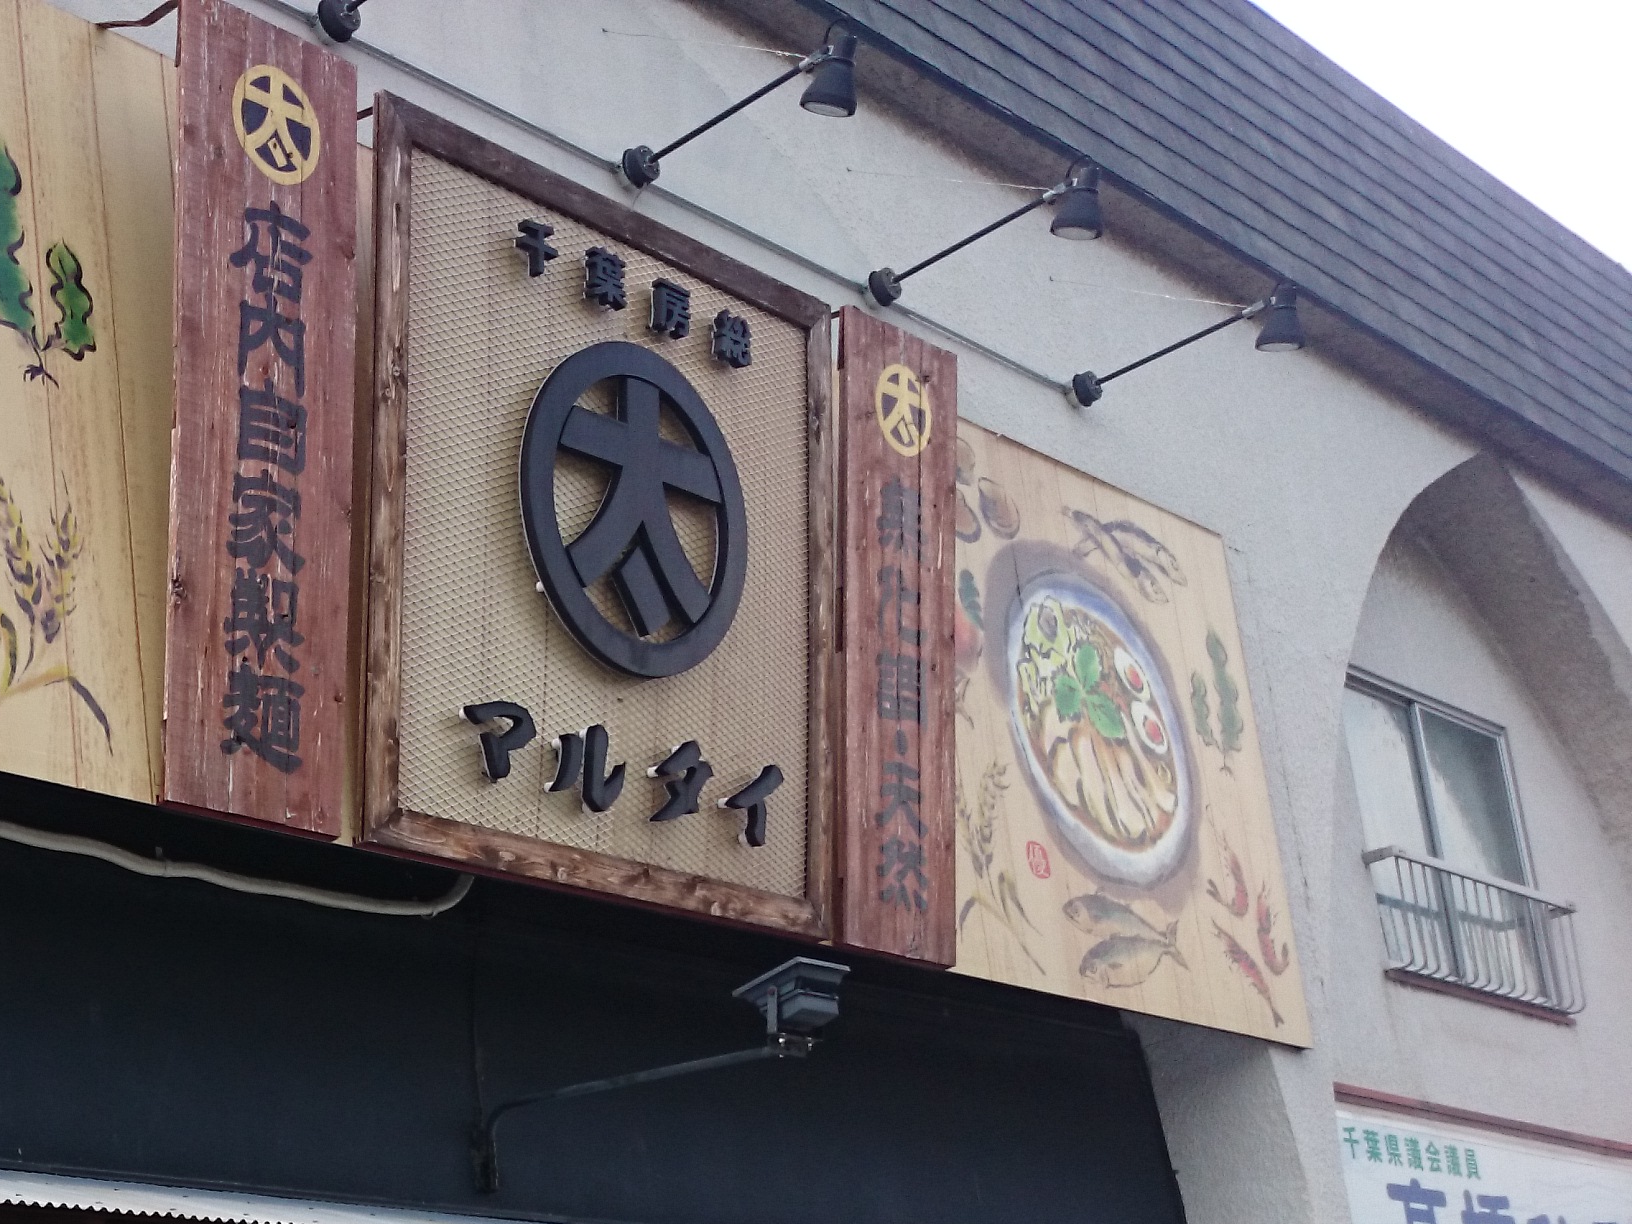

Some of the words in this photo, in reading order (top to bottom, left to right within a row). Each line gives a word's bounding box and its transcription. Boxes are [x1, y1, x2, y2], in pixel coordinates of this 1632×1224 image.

[514, 219, 752, 369] 千葉房総
[458, 700, 784, 847] マルタイ
[1342, 1126, 1482, 1181] 千葉県議会議員
